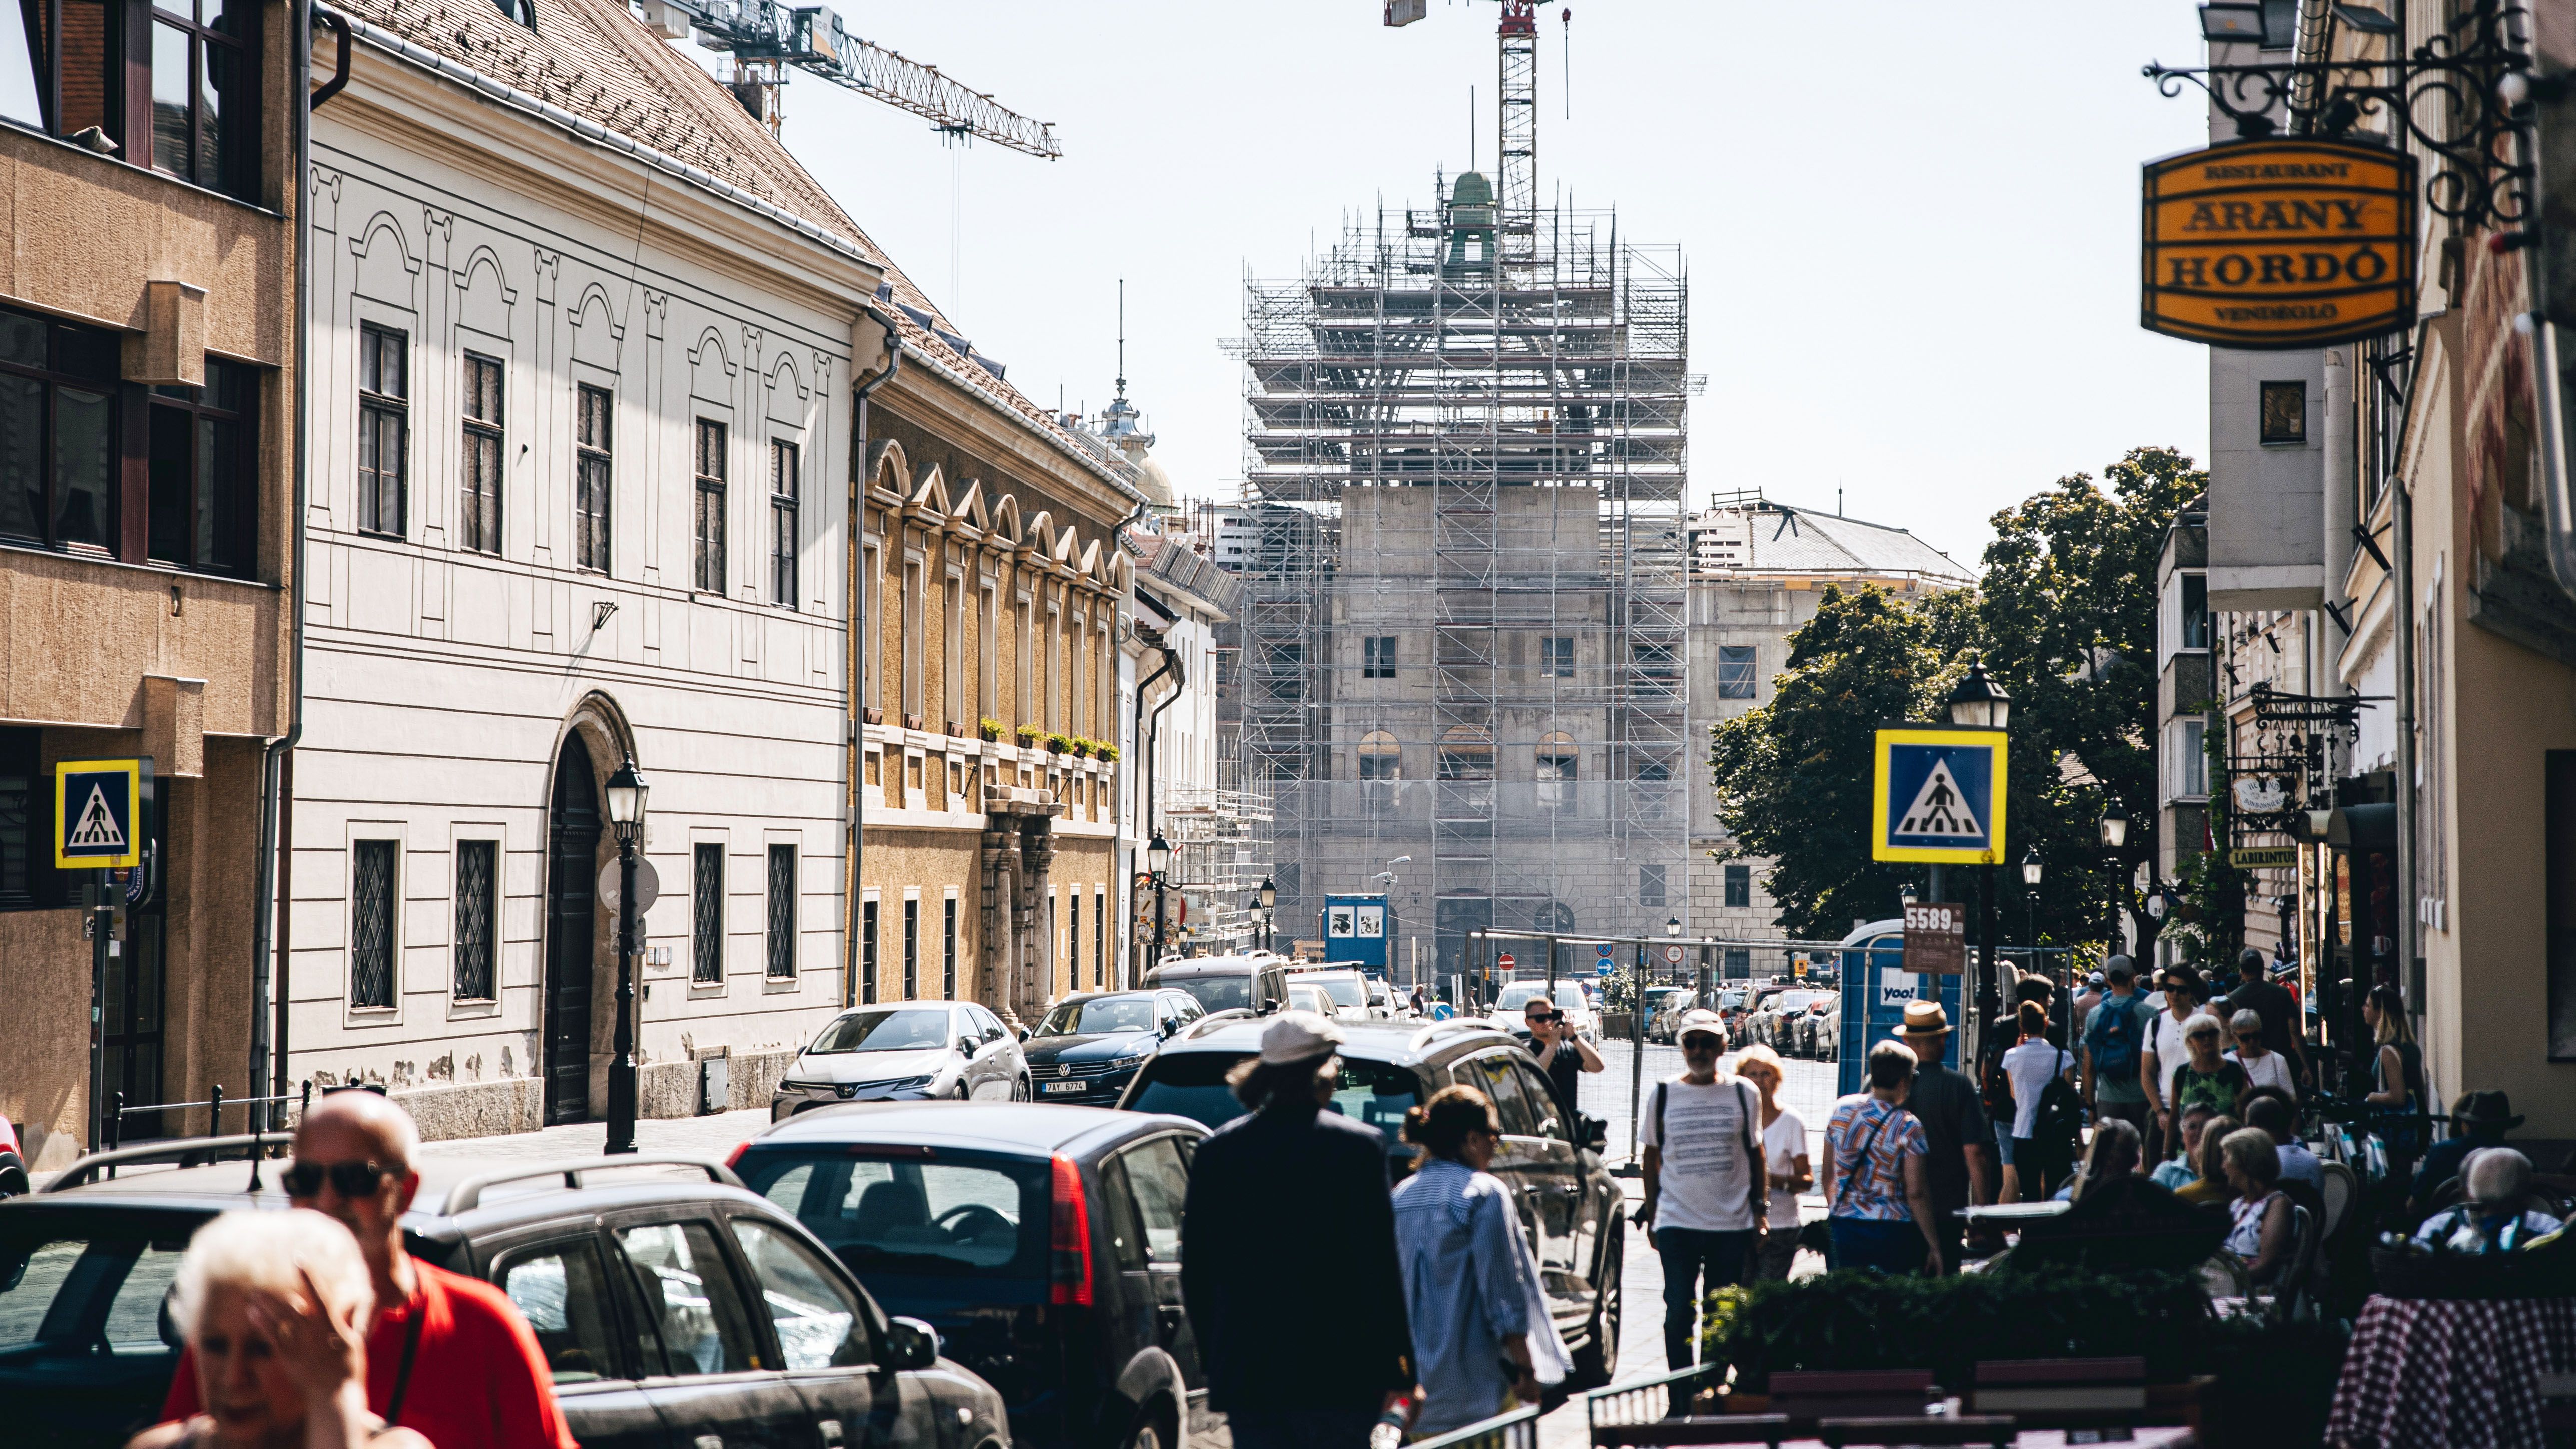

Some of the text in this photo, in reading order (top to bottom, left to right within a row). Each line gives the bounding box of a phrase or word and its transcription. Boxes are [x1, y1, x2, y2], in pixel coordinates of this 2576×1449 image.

[2205, 163, 2350, 180] RESTAURANT
[2182, 199, 2368, 231] ARANY
[2168, 244, 2387, 287] HORDÓ
[2248, 781, 2279, 791] HEND
[2235, 851, 2296, 864] LABIRINTUS
[1906, 907, 1951, 930] 5589
[1884, 987, 1915, 1001] yoo!
[1065, 1082, 1083, 1090] 6774
